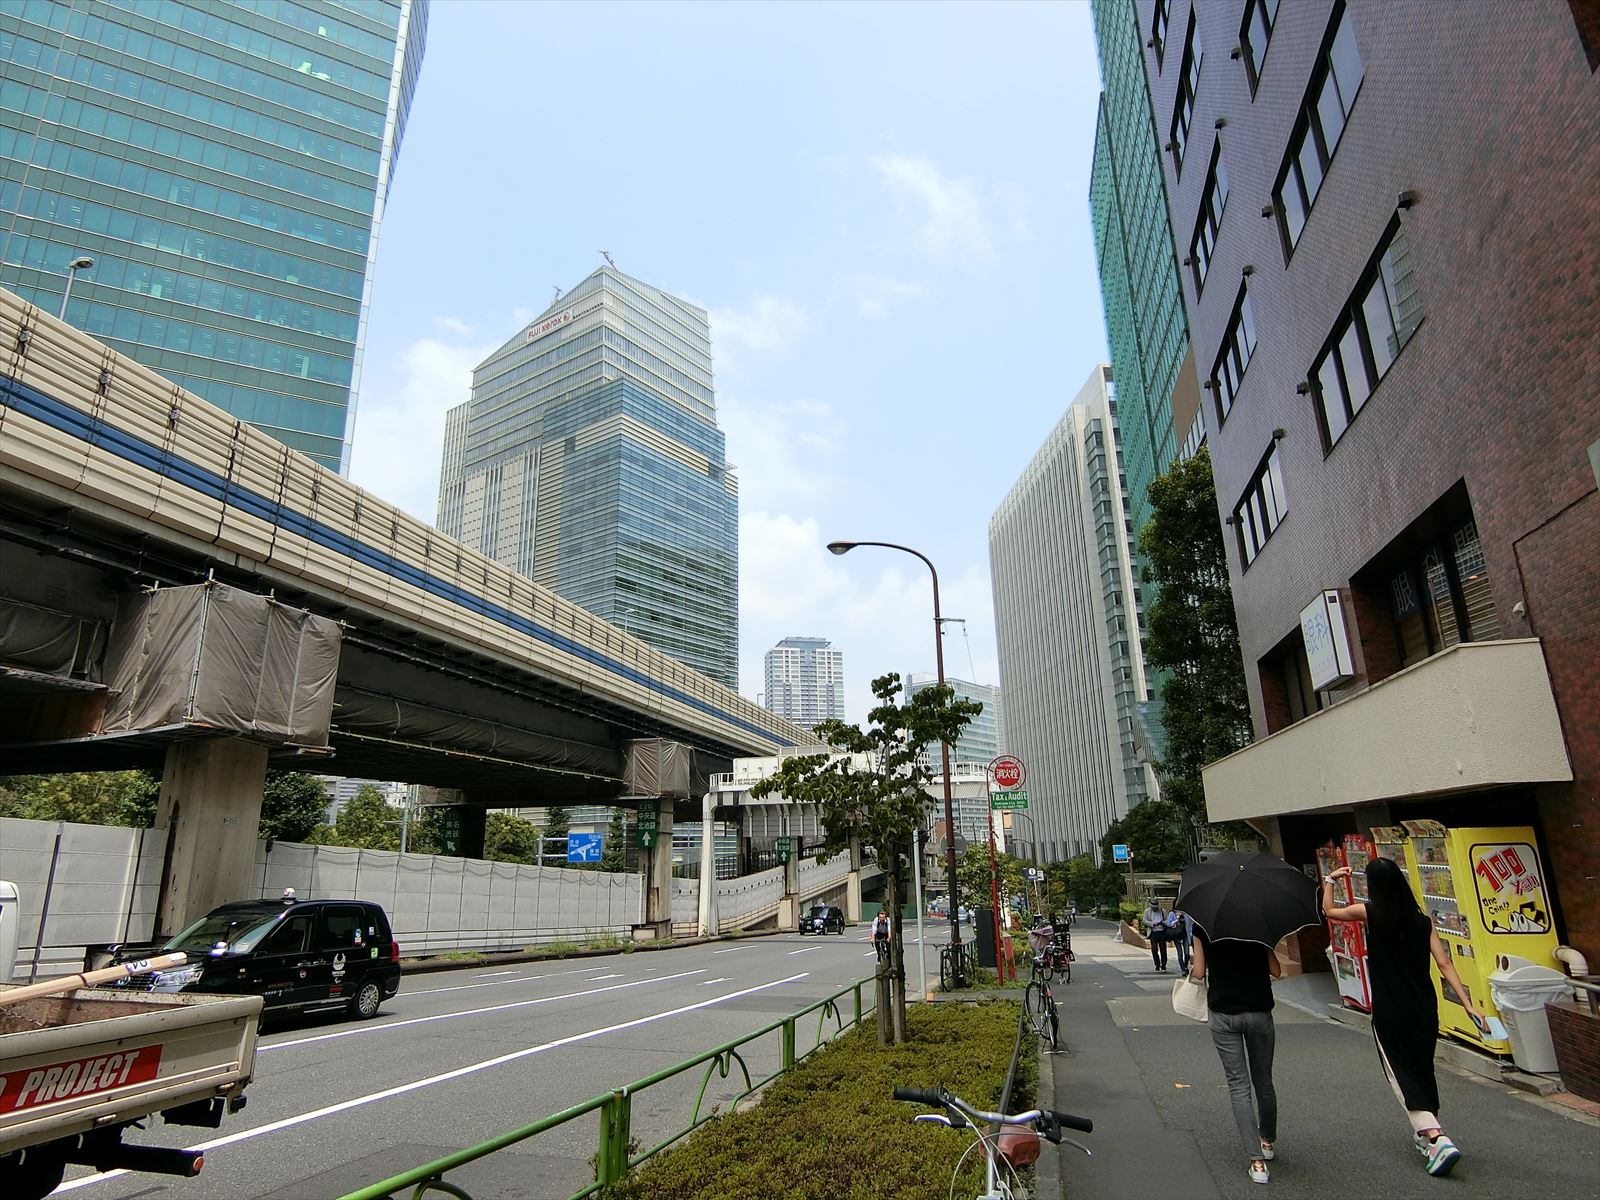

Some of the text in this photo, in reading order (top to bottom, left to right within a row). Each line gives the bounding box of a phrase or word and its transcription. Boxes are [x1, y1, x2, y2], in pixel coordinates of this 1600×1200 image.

[1303, 607, 1330, 656] 眼科
[996, 768, 1019, 779] 消火栓
[991, 792, 1004, 801] Tax
[1008, 791, 1027, 800] Audit
[1476, 847, 1527, 893] 100
[1482, 897, 1498, 907] One
[15, 1051, 141, 1108] PROJECT
